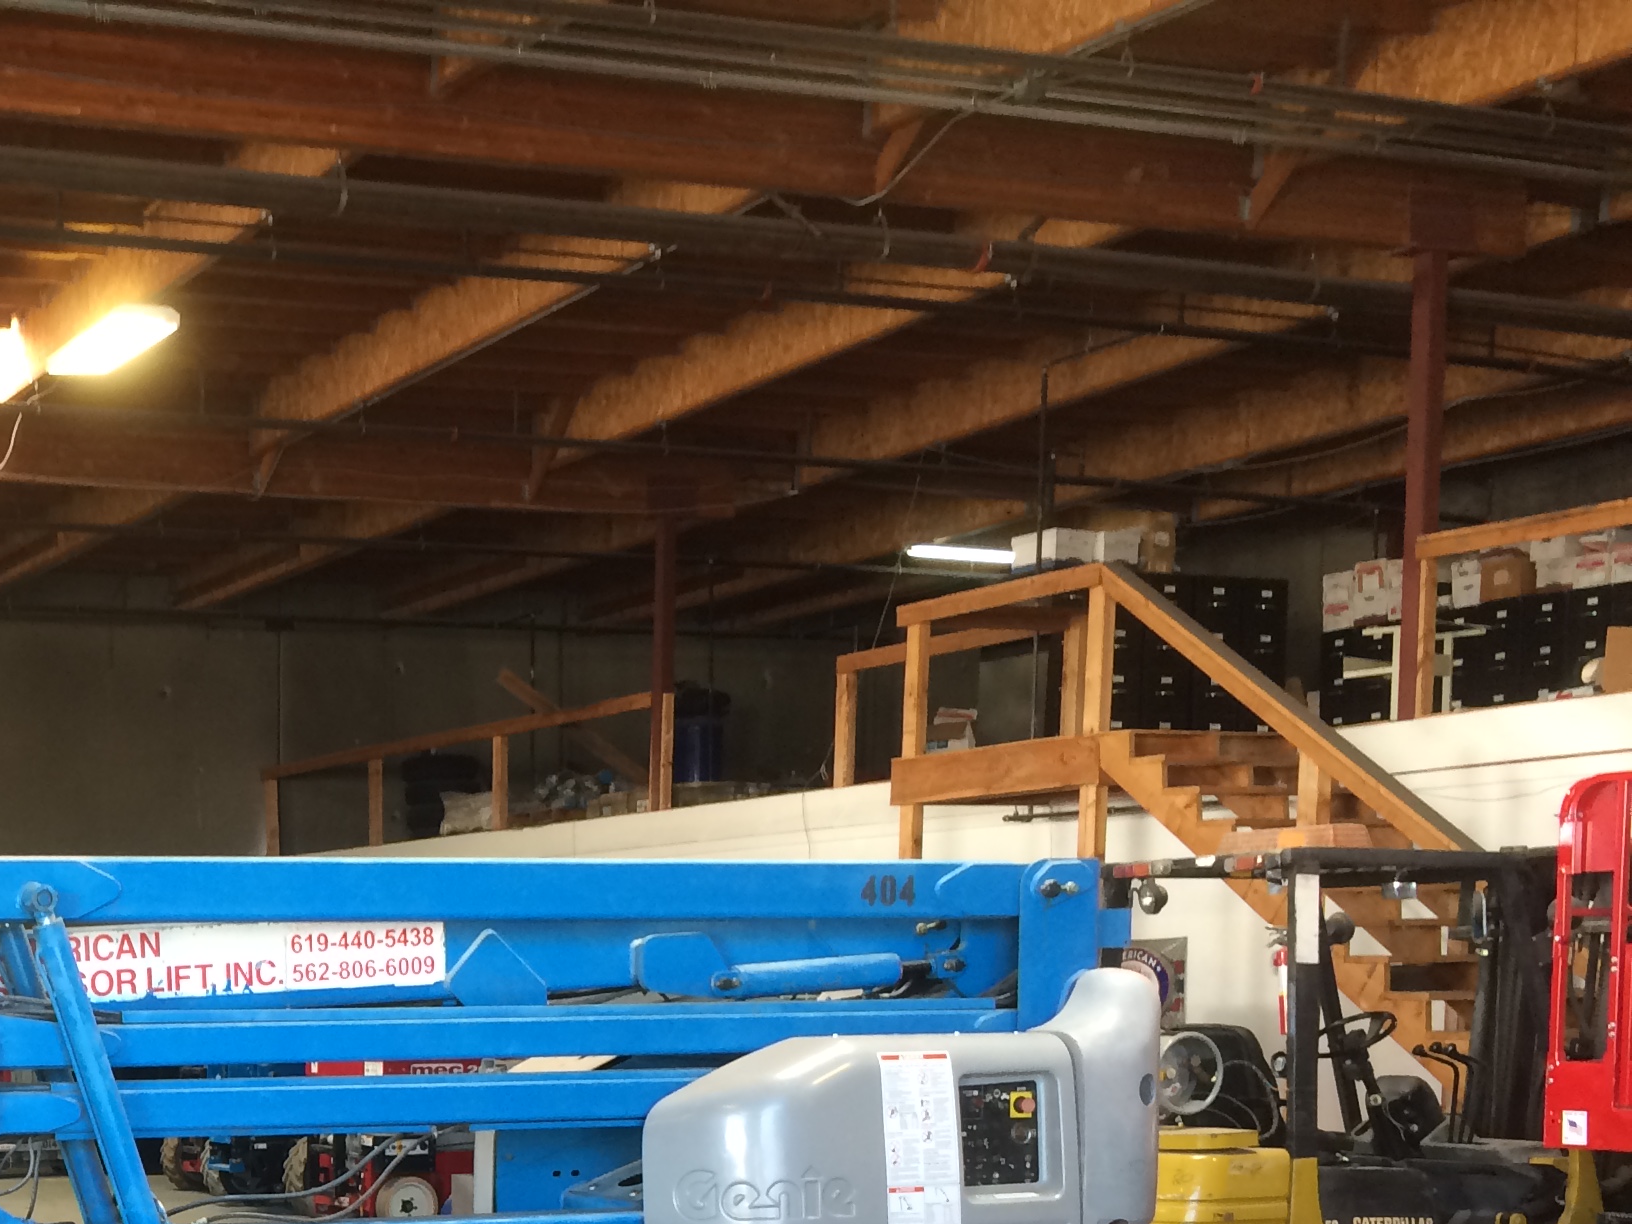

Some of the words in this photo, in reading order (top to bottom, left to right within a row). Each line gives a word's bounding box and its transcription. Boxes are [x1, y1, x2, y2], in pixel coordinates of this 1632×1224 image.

[861, 875, 915, 907] 404
[291, 926, 434, 954] 619-440-5438
[147, 963, 213, 993] LIFT
[225, 959, 284, 990] INC.
[293, 956, 435, 983] 562-806-6009
[672, 1165, 856, 1221] Genie
